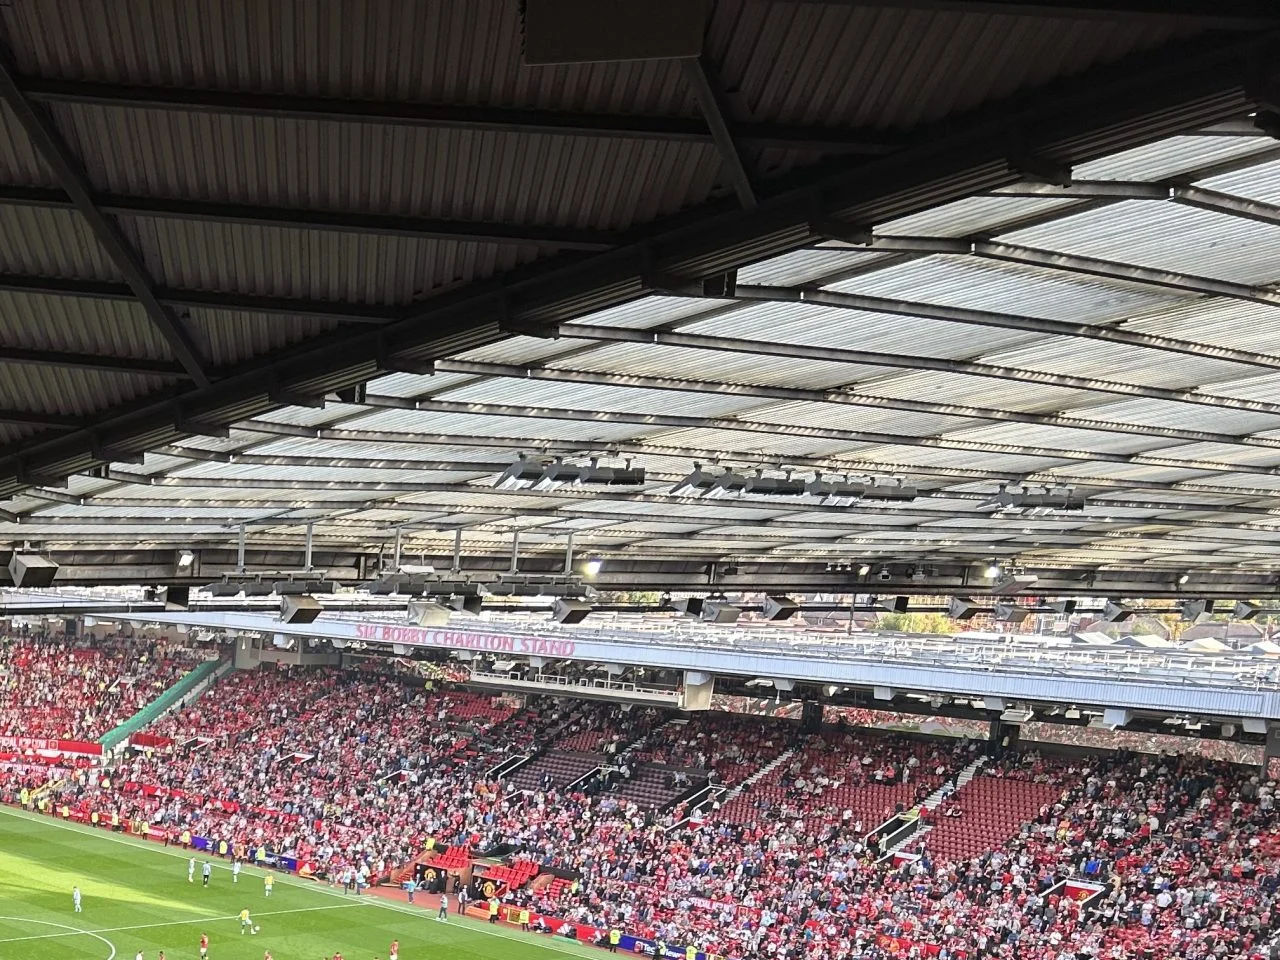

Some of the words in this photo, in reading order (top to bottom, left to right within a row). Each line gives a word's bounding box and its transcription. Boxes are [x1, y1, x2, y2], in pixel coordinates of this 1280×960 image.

[355, 623, 377, 640] SIR
[382, 625, 427, 644] BOBBY
[521, 637, 576, 657] STAND
